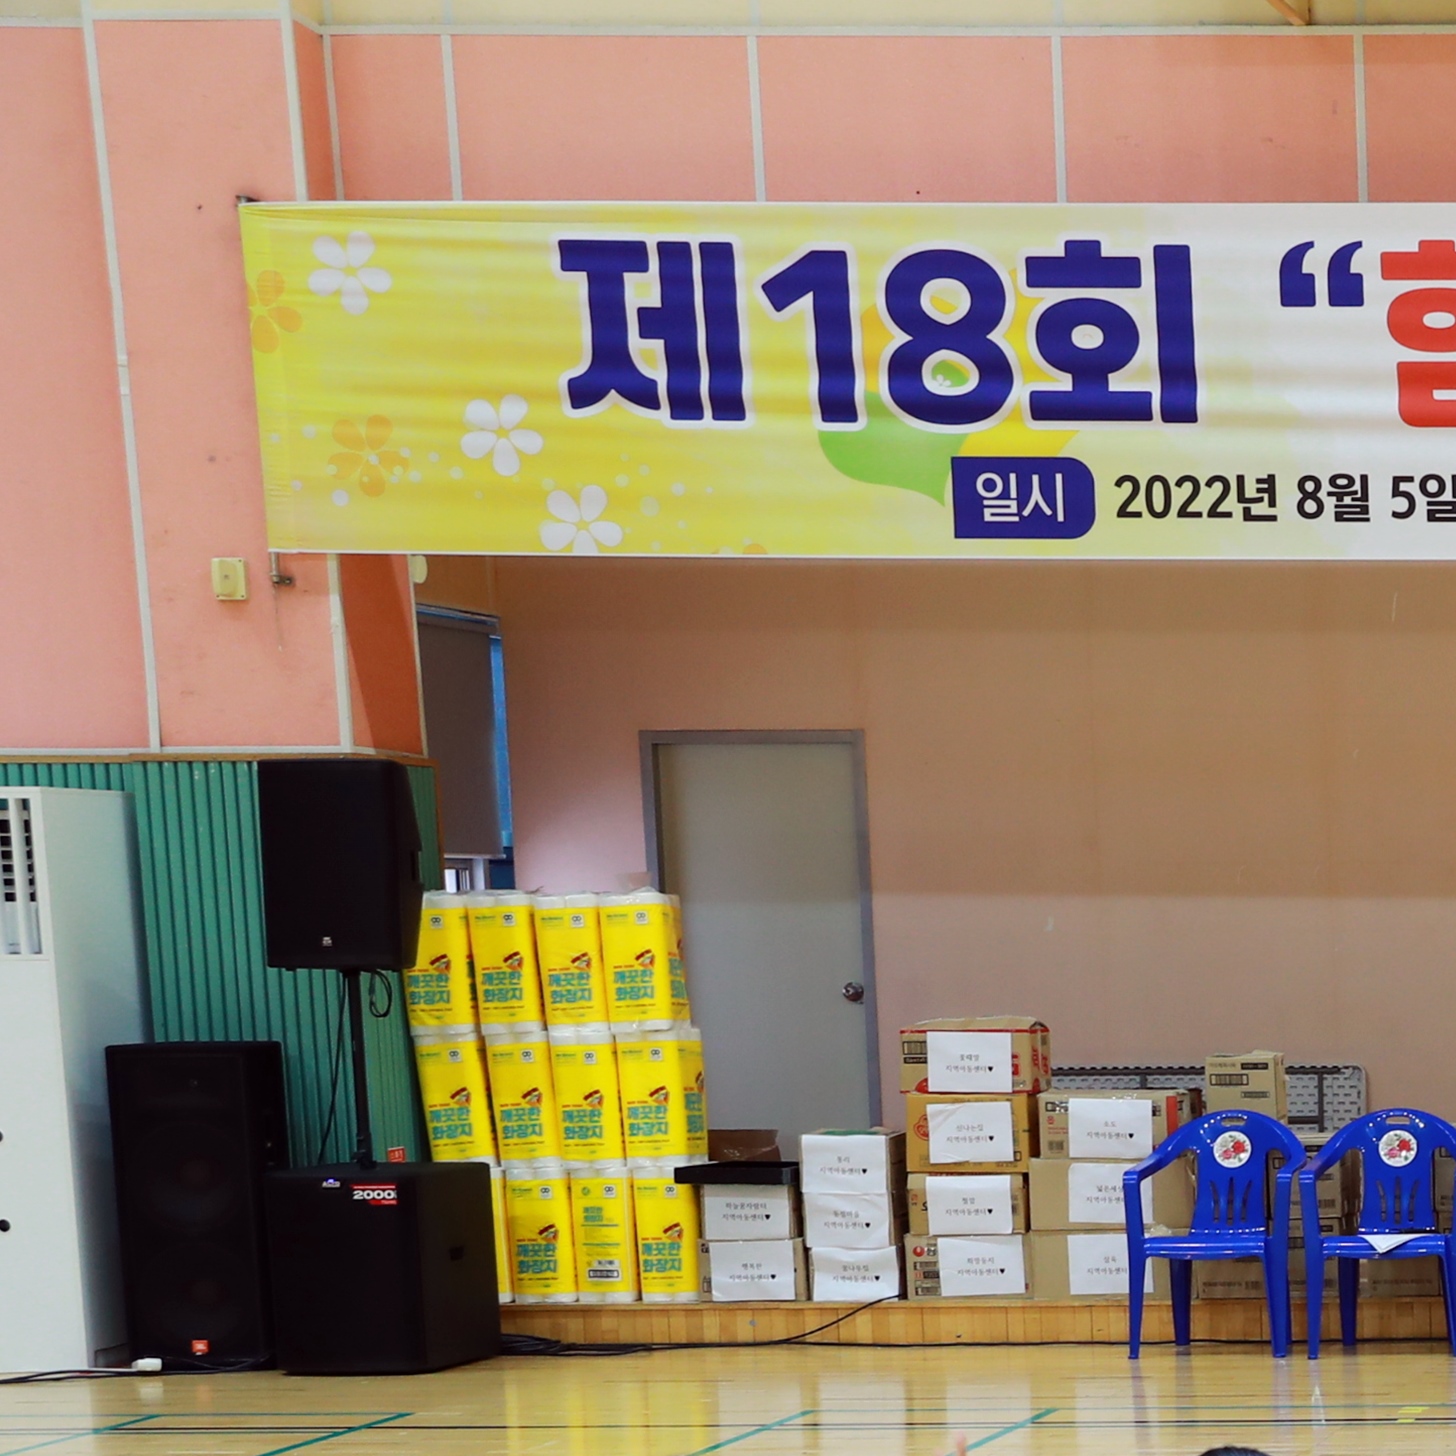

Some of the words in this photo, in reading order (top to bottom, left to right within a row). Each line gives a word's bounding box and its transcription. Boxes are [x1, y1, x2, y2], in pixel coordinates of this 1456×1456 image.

[557, 238, 1199, 426] 제18회
[975, 472, 1065, 523] 일시
[1113, 472, 1279, 523] 2022년
[1295, 472, 1372, 524] 8월
[1086, 1196, 1124, 1204] 지역아동센
